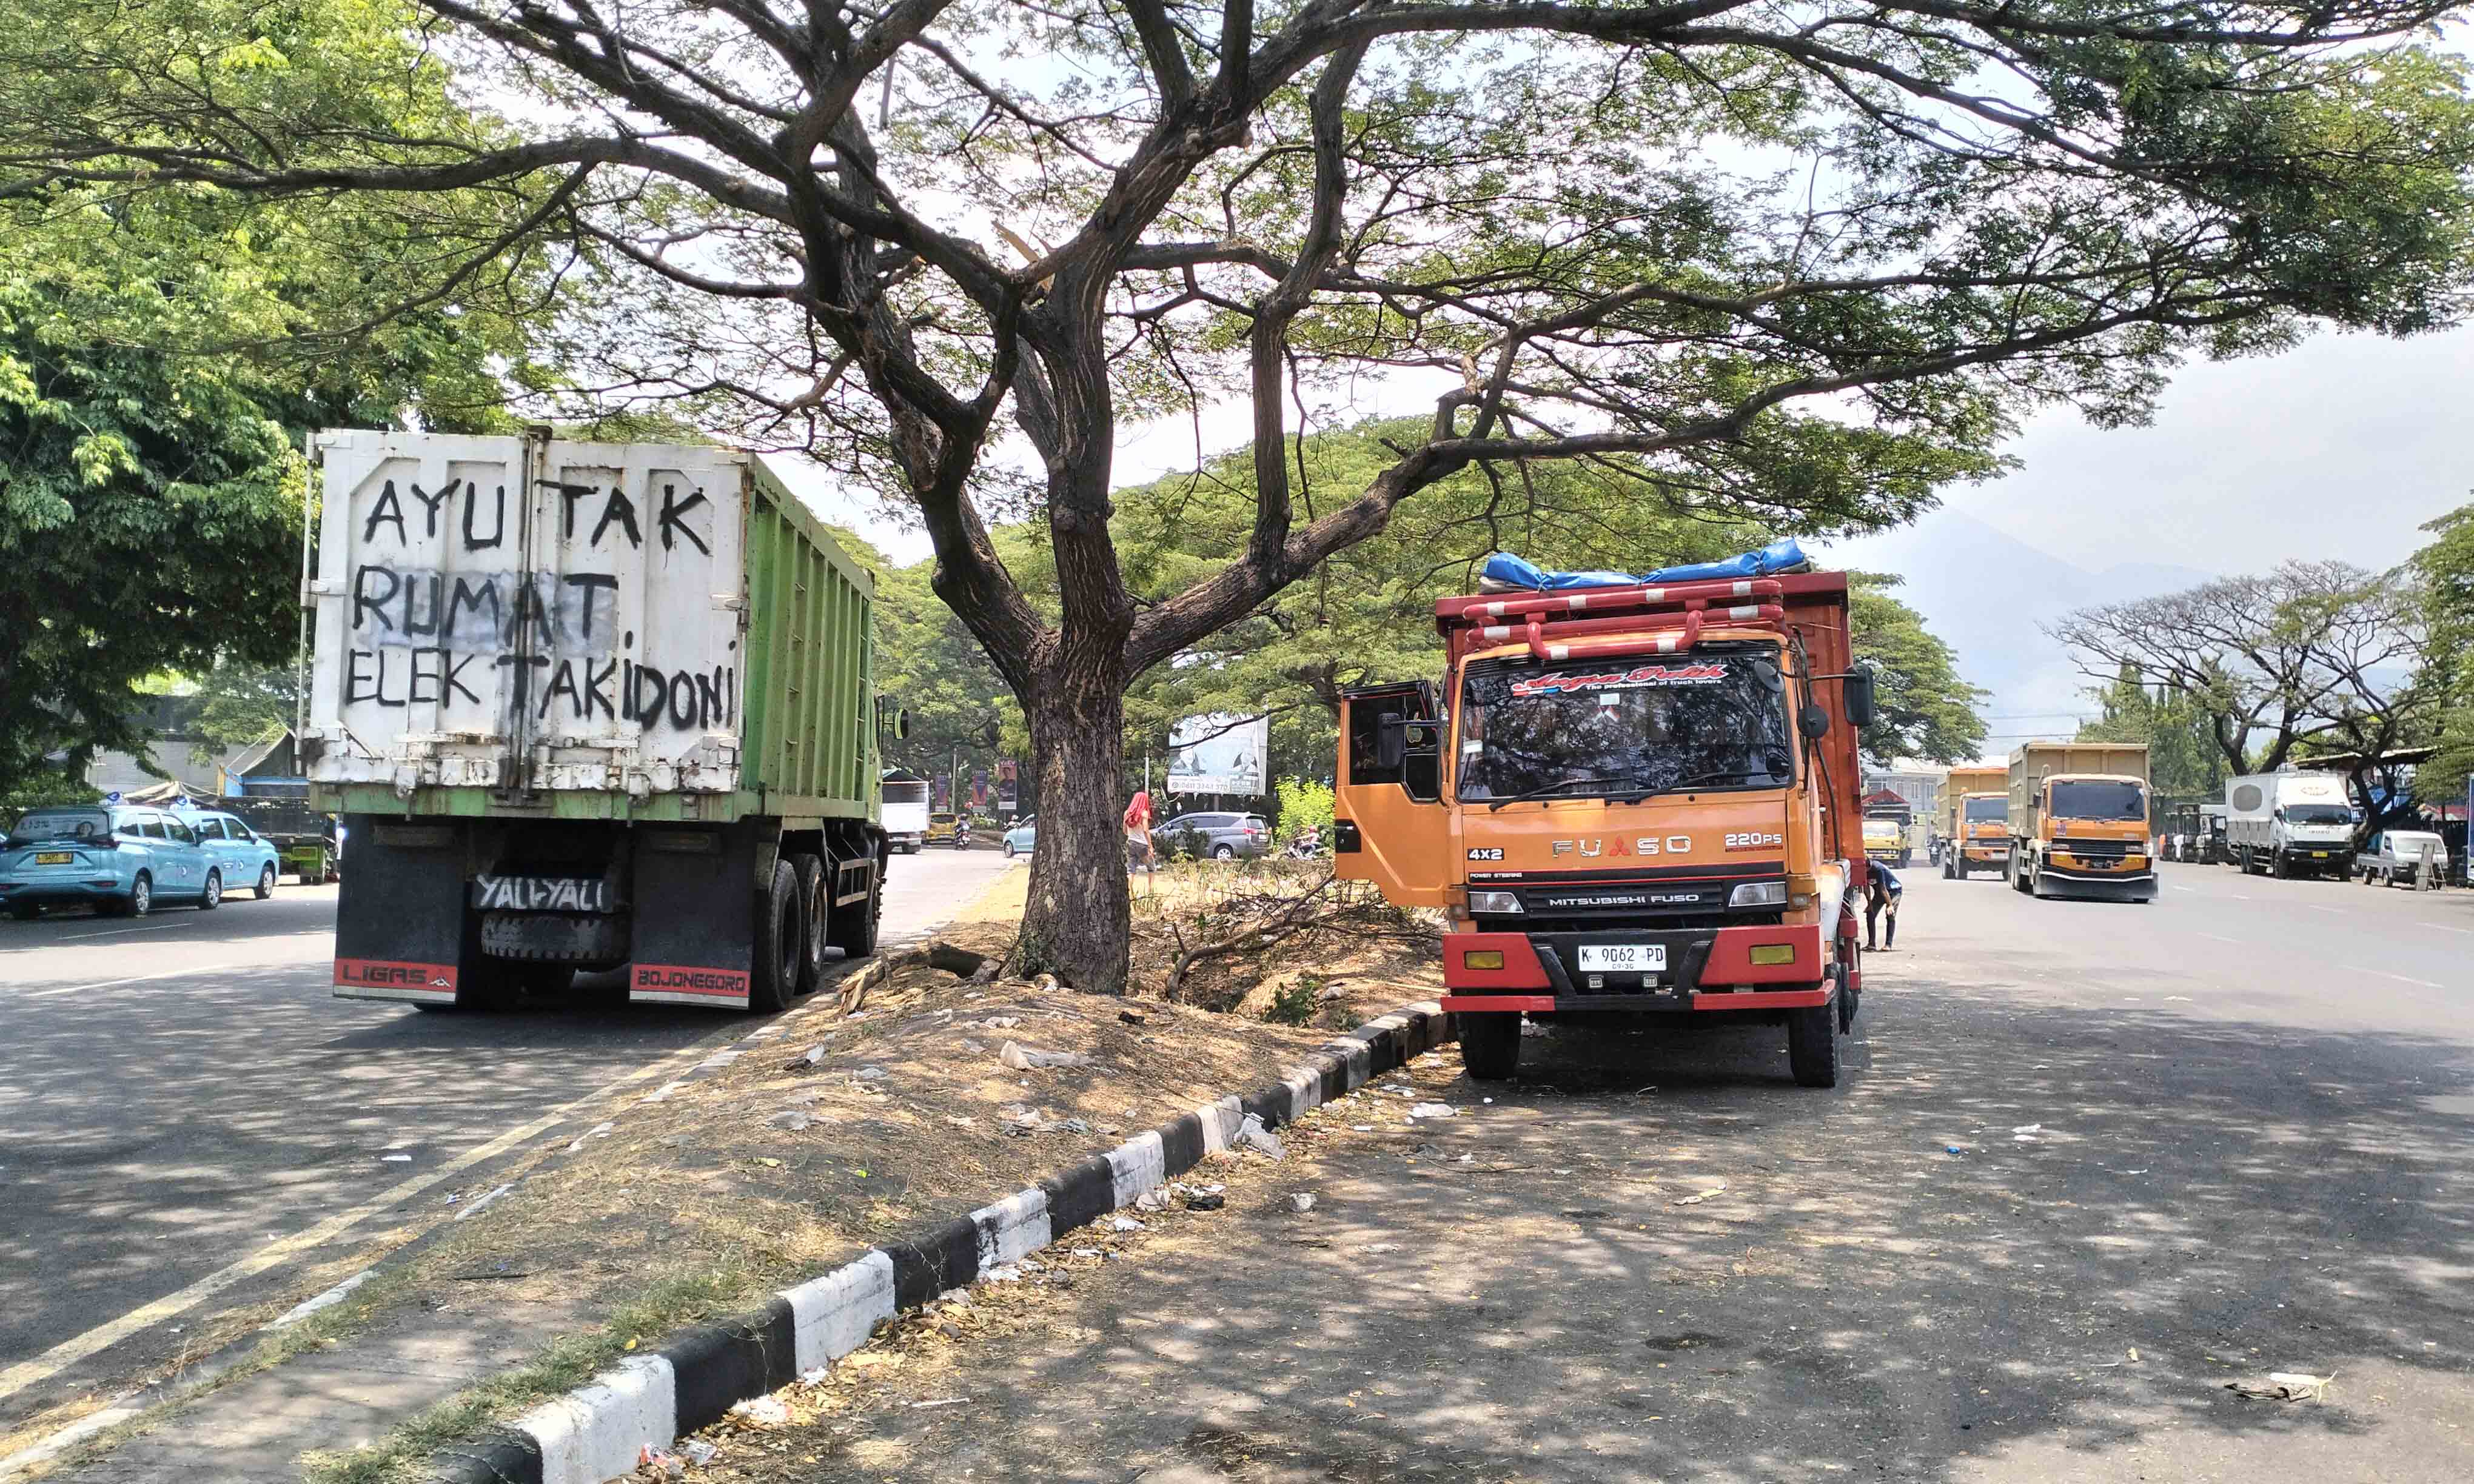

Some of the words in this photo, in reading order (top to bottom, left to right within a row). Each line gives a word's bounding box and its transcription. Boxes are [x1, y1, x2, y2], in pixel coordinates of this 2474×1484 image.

[363, 478, 505, 550] AYU
[534, 479, 710, 556] TAK
[352, 565, 619, 647] RUMAT
[344, 647, 480, 707] ELEK
[1725, 832, 1783, 847] 220PS
[1549, 896, 1646, 907] MITSUBISHI
[1651, 894, 1699, 903] FUSO
[1581, 948, 1590, 963] K
[1601, 948, 1635, 962] 9062
[1646, 948, 1664, 962] PD
[638, 969, 746, 992] BOJONEGORO
